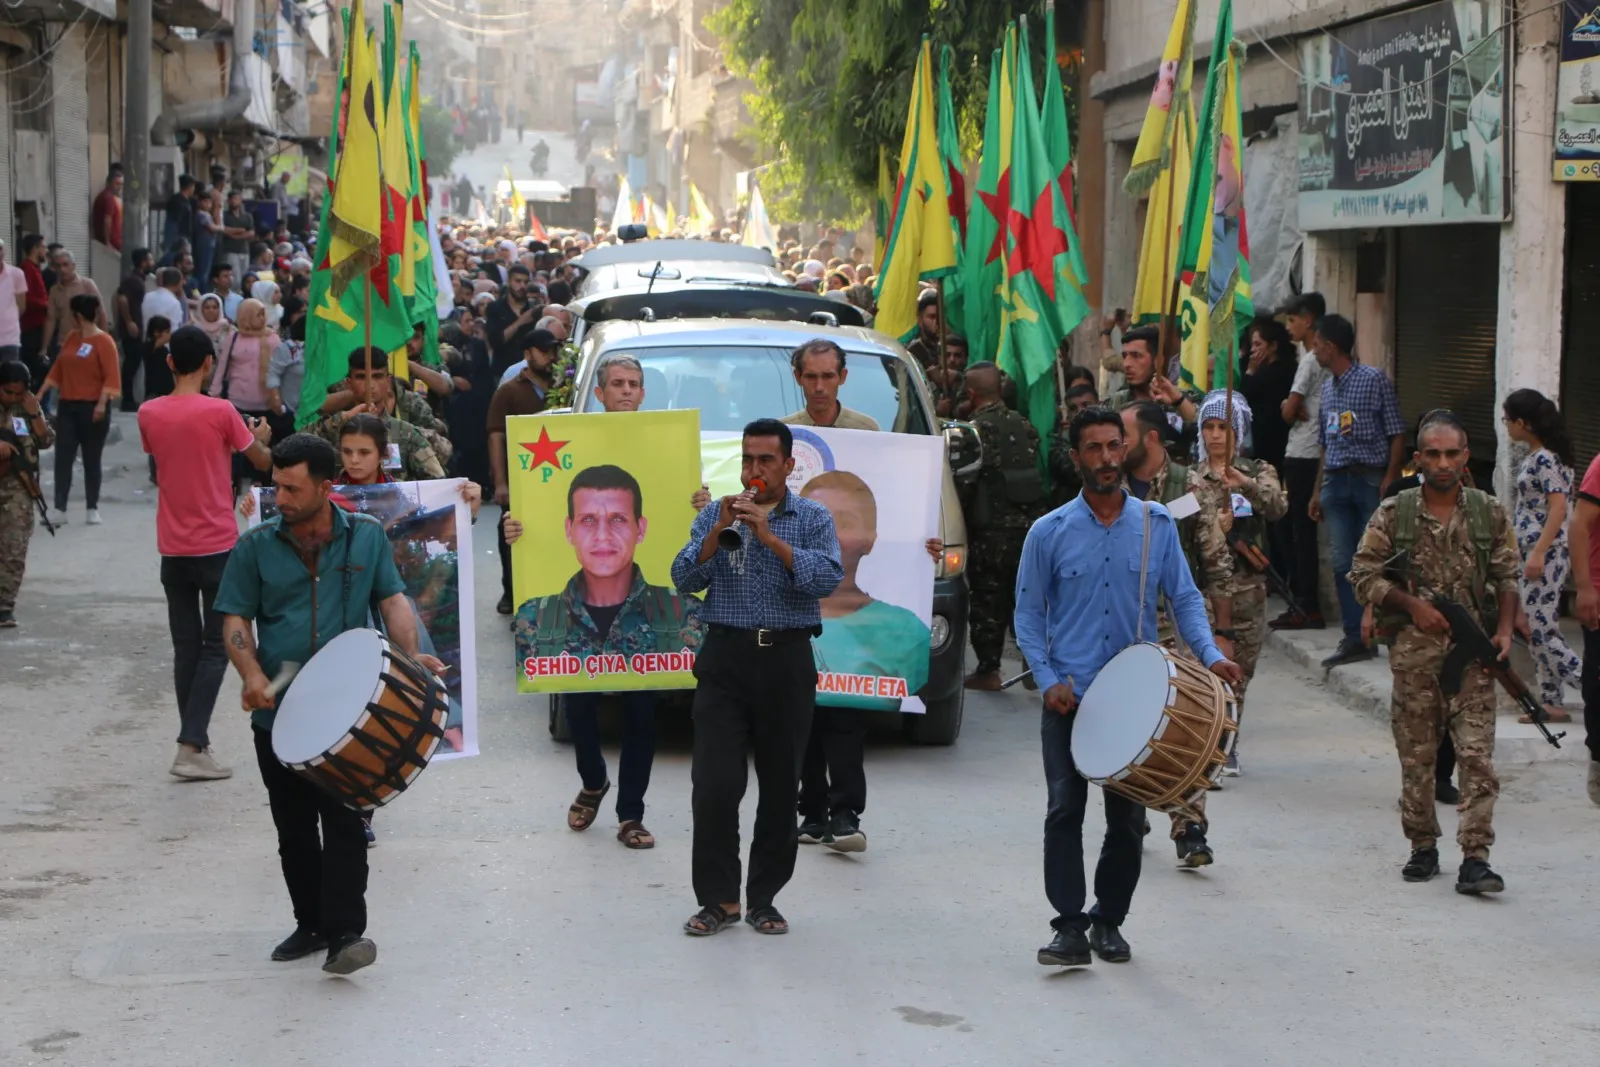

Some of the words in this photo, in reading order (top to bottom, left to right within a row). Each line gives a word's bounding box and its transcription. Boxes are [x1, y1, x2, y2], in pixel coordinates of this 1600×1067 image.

[525, 651, 581, 681] ŞEHÎD
[585, 655, 627, 679] ÇIYA
[877, 676, 908, 698] ETA
